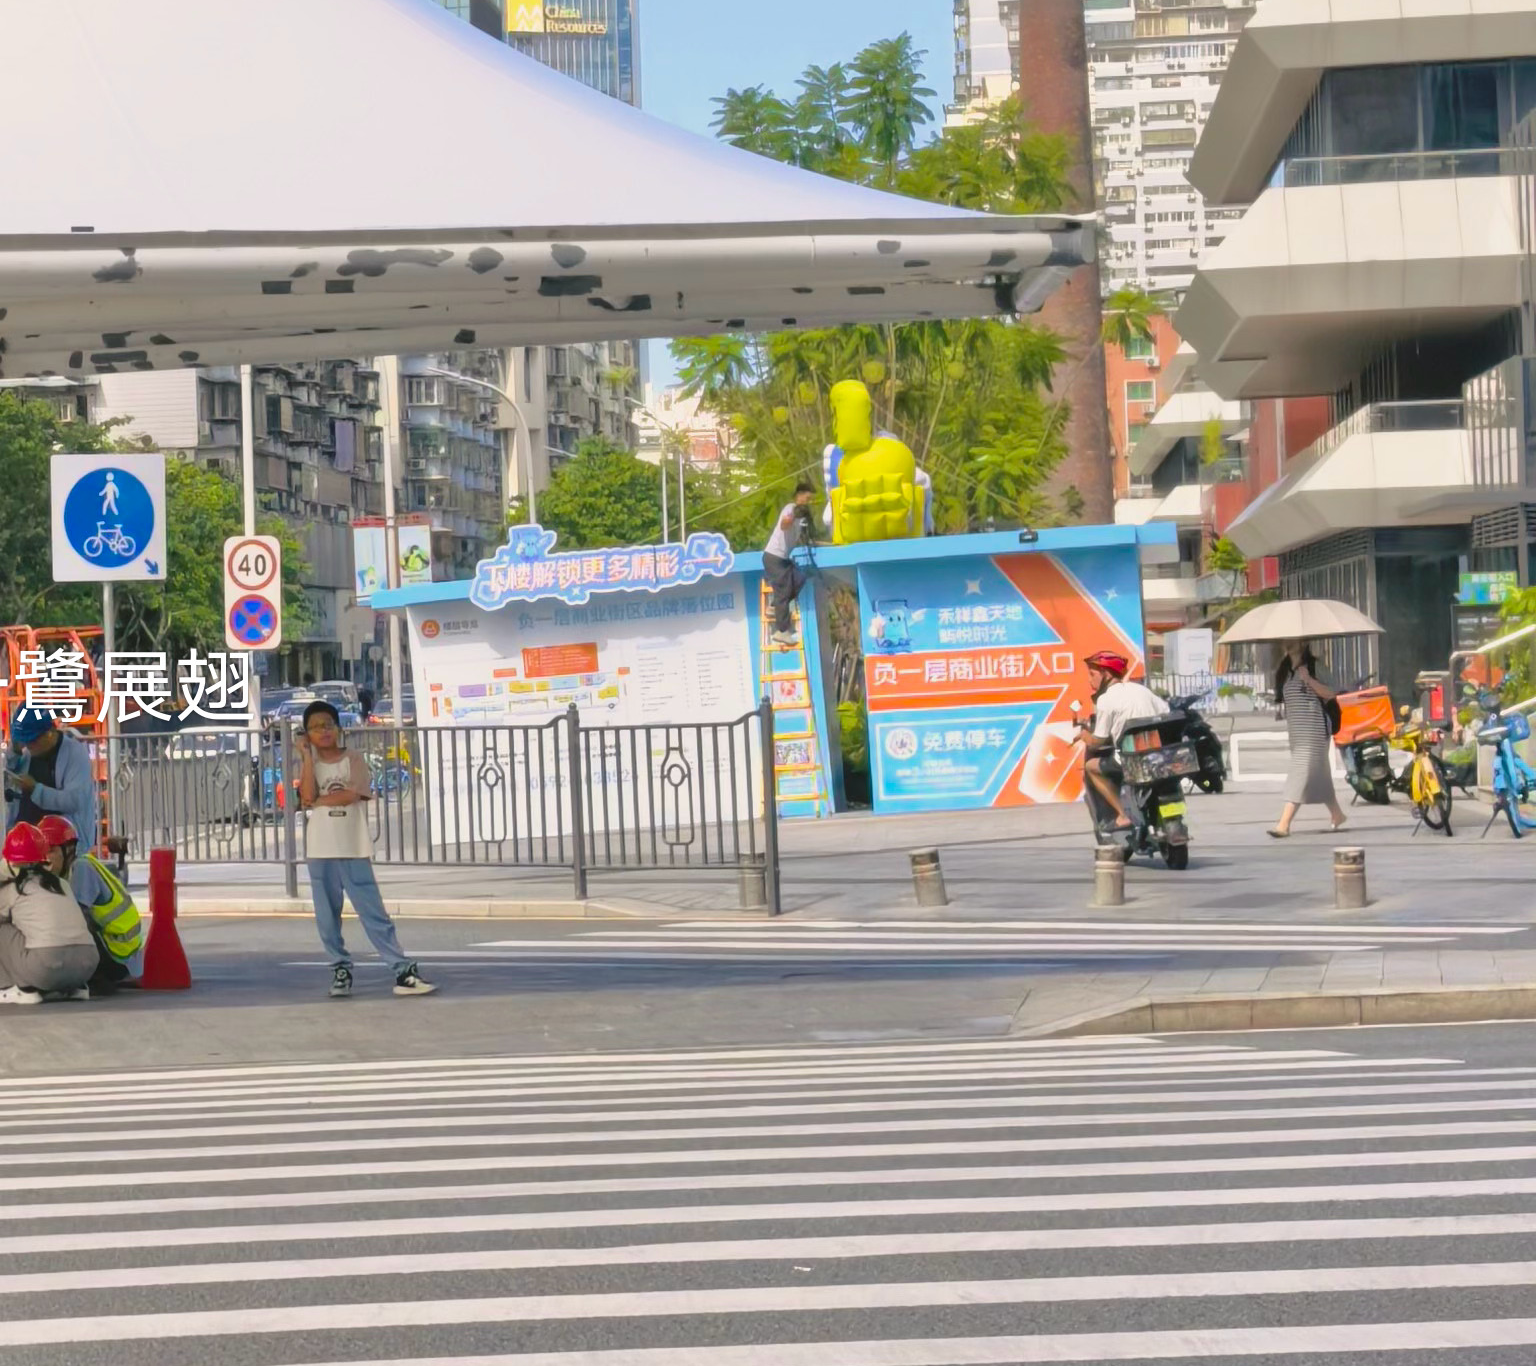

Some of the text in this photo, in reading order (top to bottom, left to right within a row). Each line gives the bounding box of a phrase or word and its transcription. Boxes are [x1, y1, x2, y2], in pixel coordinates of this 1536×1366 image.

[546, 19, 607, 34] Resources
[238, 554, 267, 577] 40
[484, 550, 679, 593] 下楼解锁更多精彩
[873, 651, 1076, 686] 负一层商业街入口
[923, 728, 1007, 753] 免费停车
